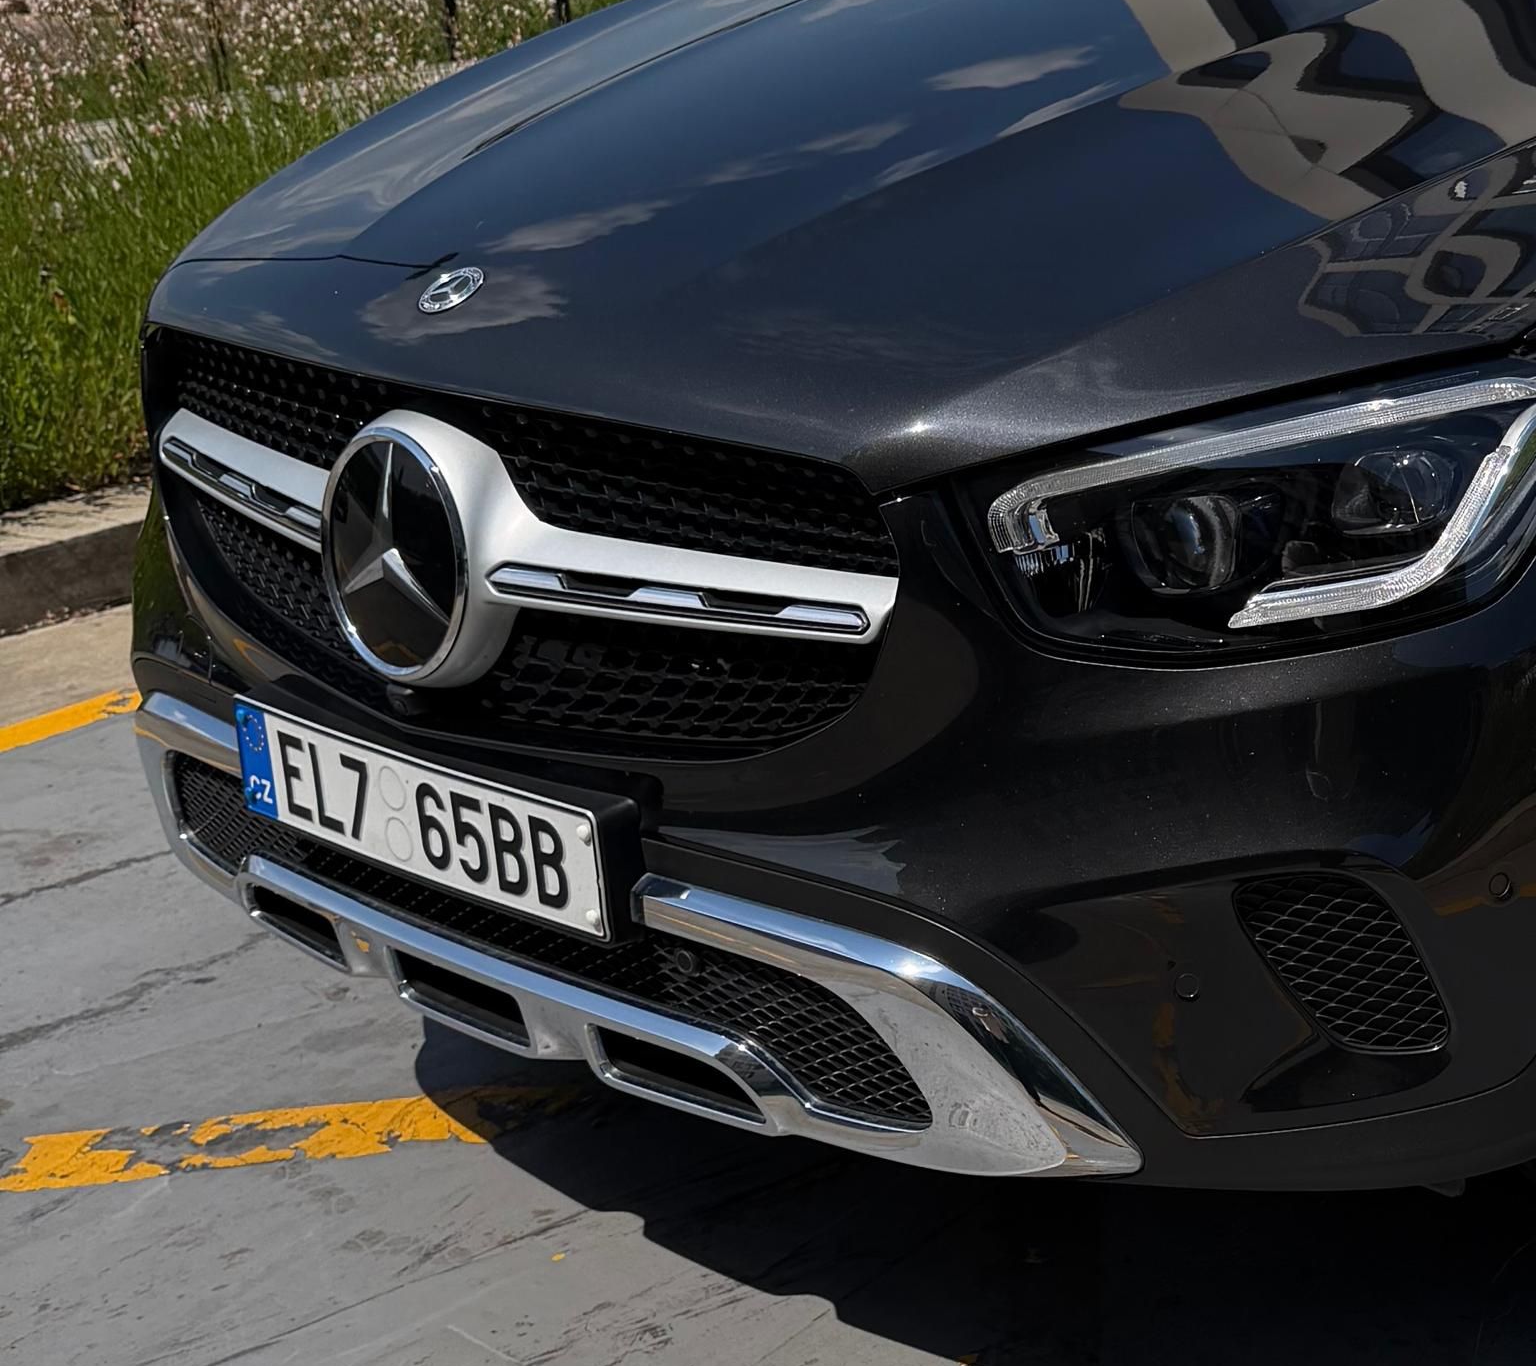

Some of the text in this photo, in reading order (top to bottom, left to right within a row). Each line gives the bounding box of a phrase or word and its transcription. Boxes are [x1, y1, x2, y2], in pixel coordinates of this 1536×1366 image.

[249, 774, 273, 804] CZ
[277, 730, 570, 909] EL7 65BB
